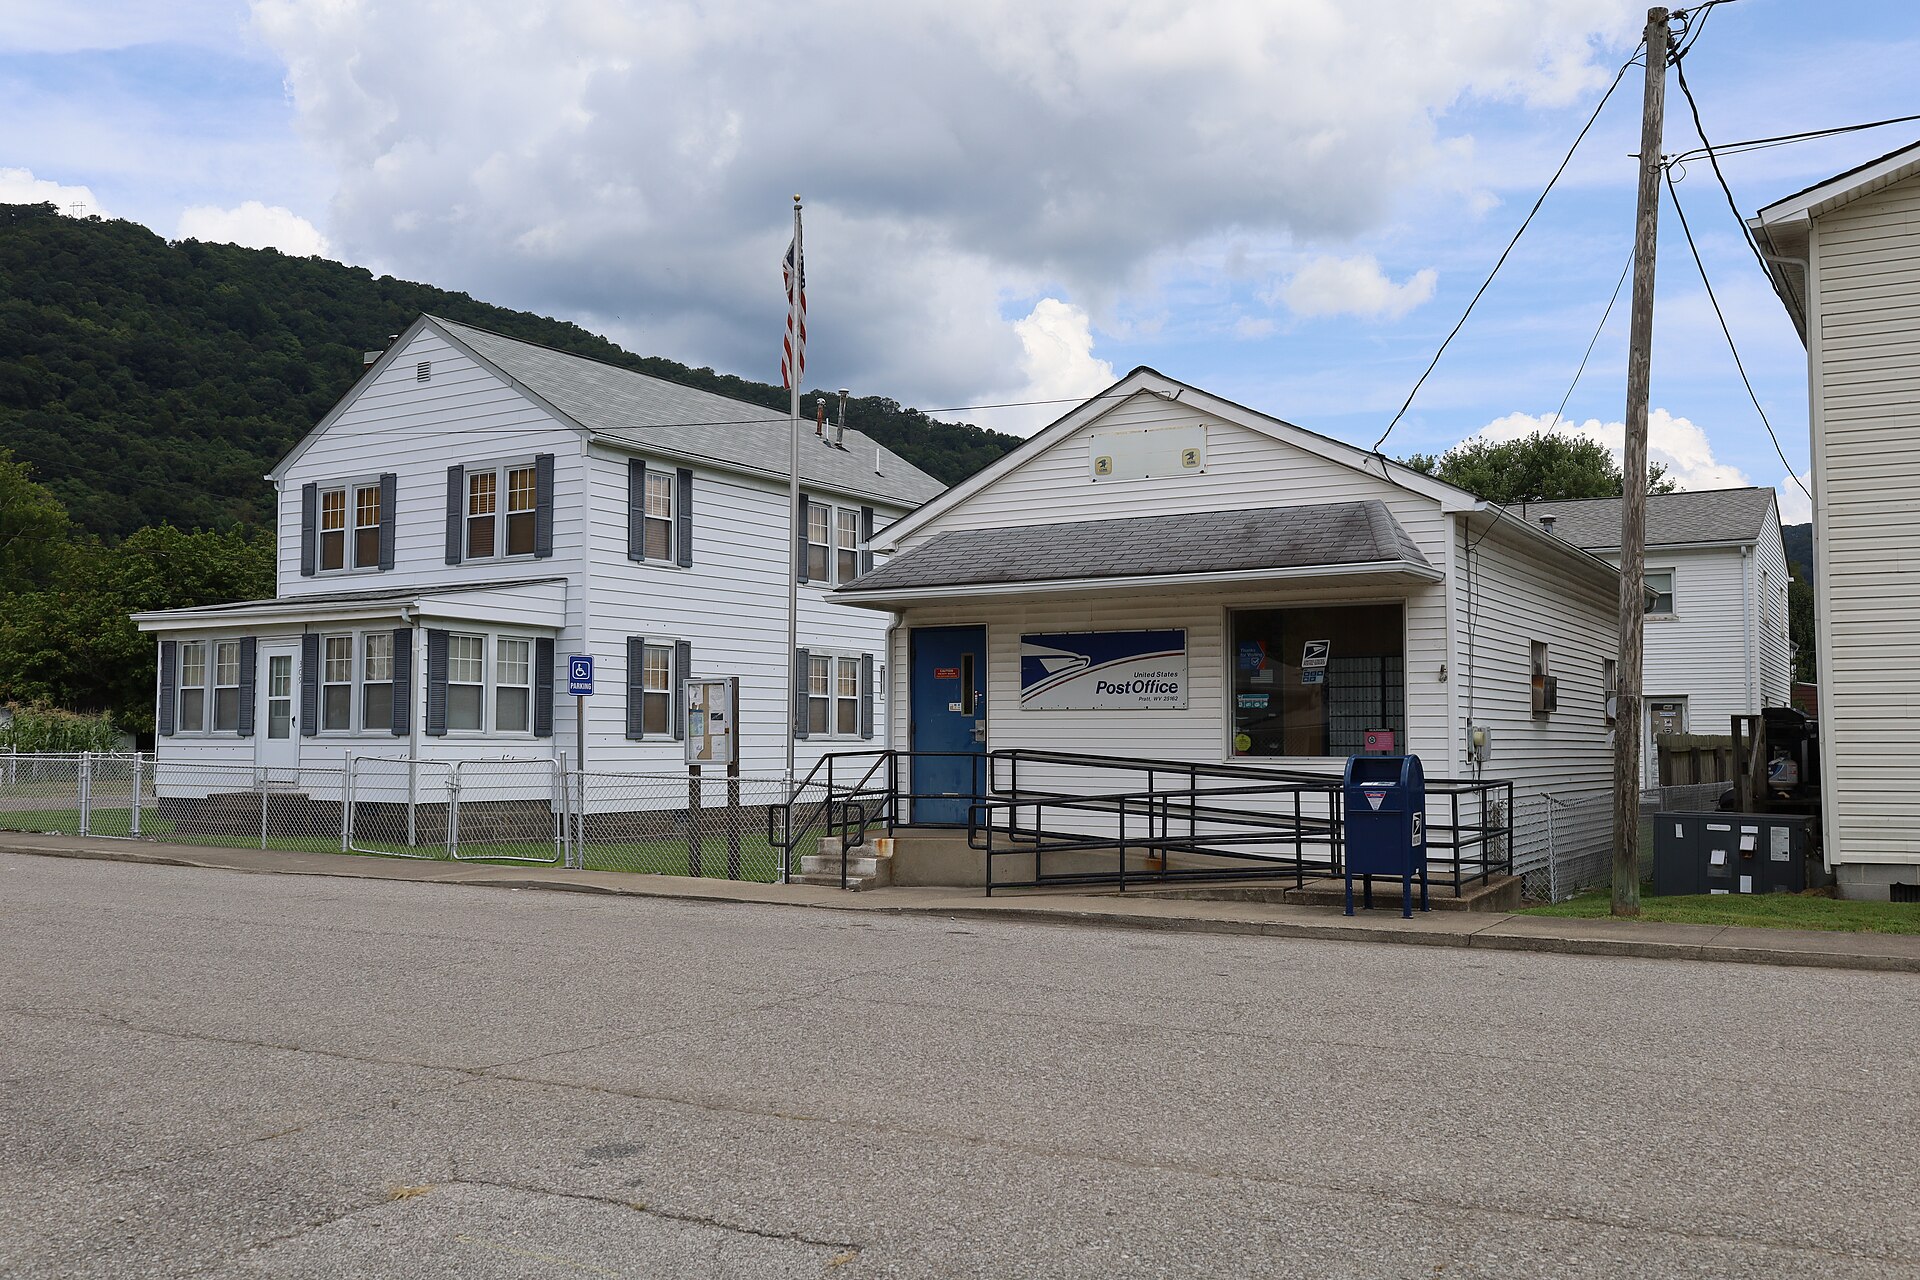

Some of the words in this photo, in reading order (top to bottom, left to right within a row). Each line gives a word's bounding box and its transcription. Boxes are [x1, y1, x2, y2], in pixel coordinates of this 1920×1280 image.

[570, 682, 591, 690] PARKING
[1096, 680, 1131, 694] Post
[1132, 679, 1179, 694] Office
